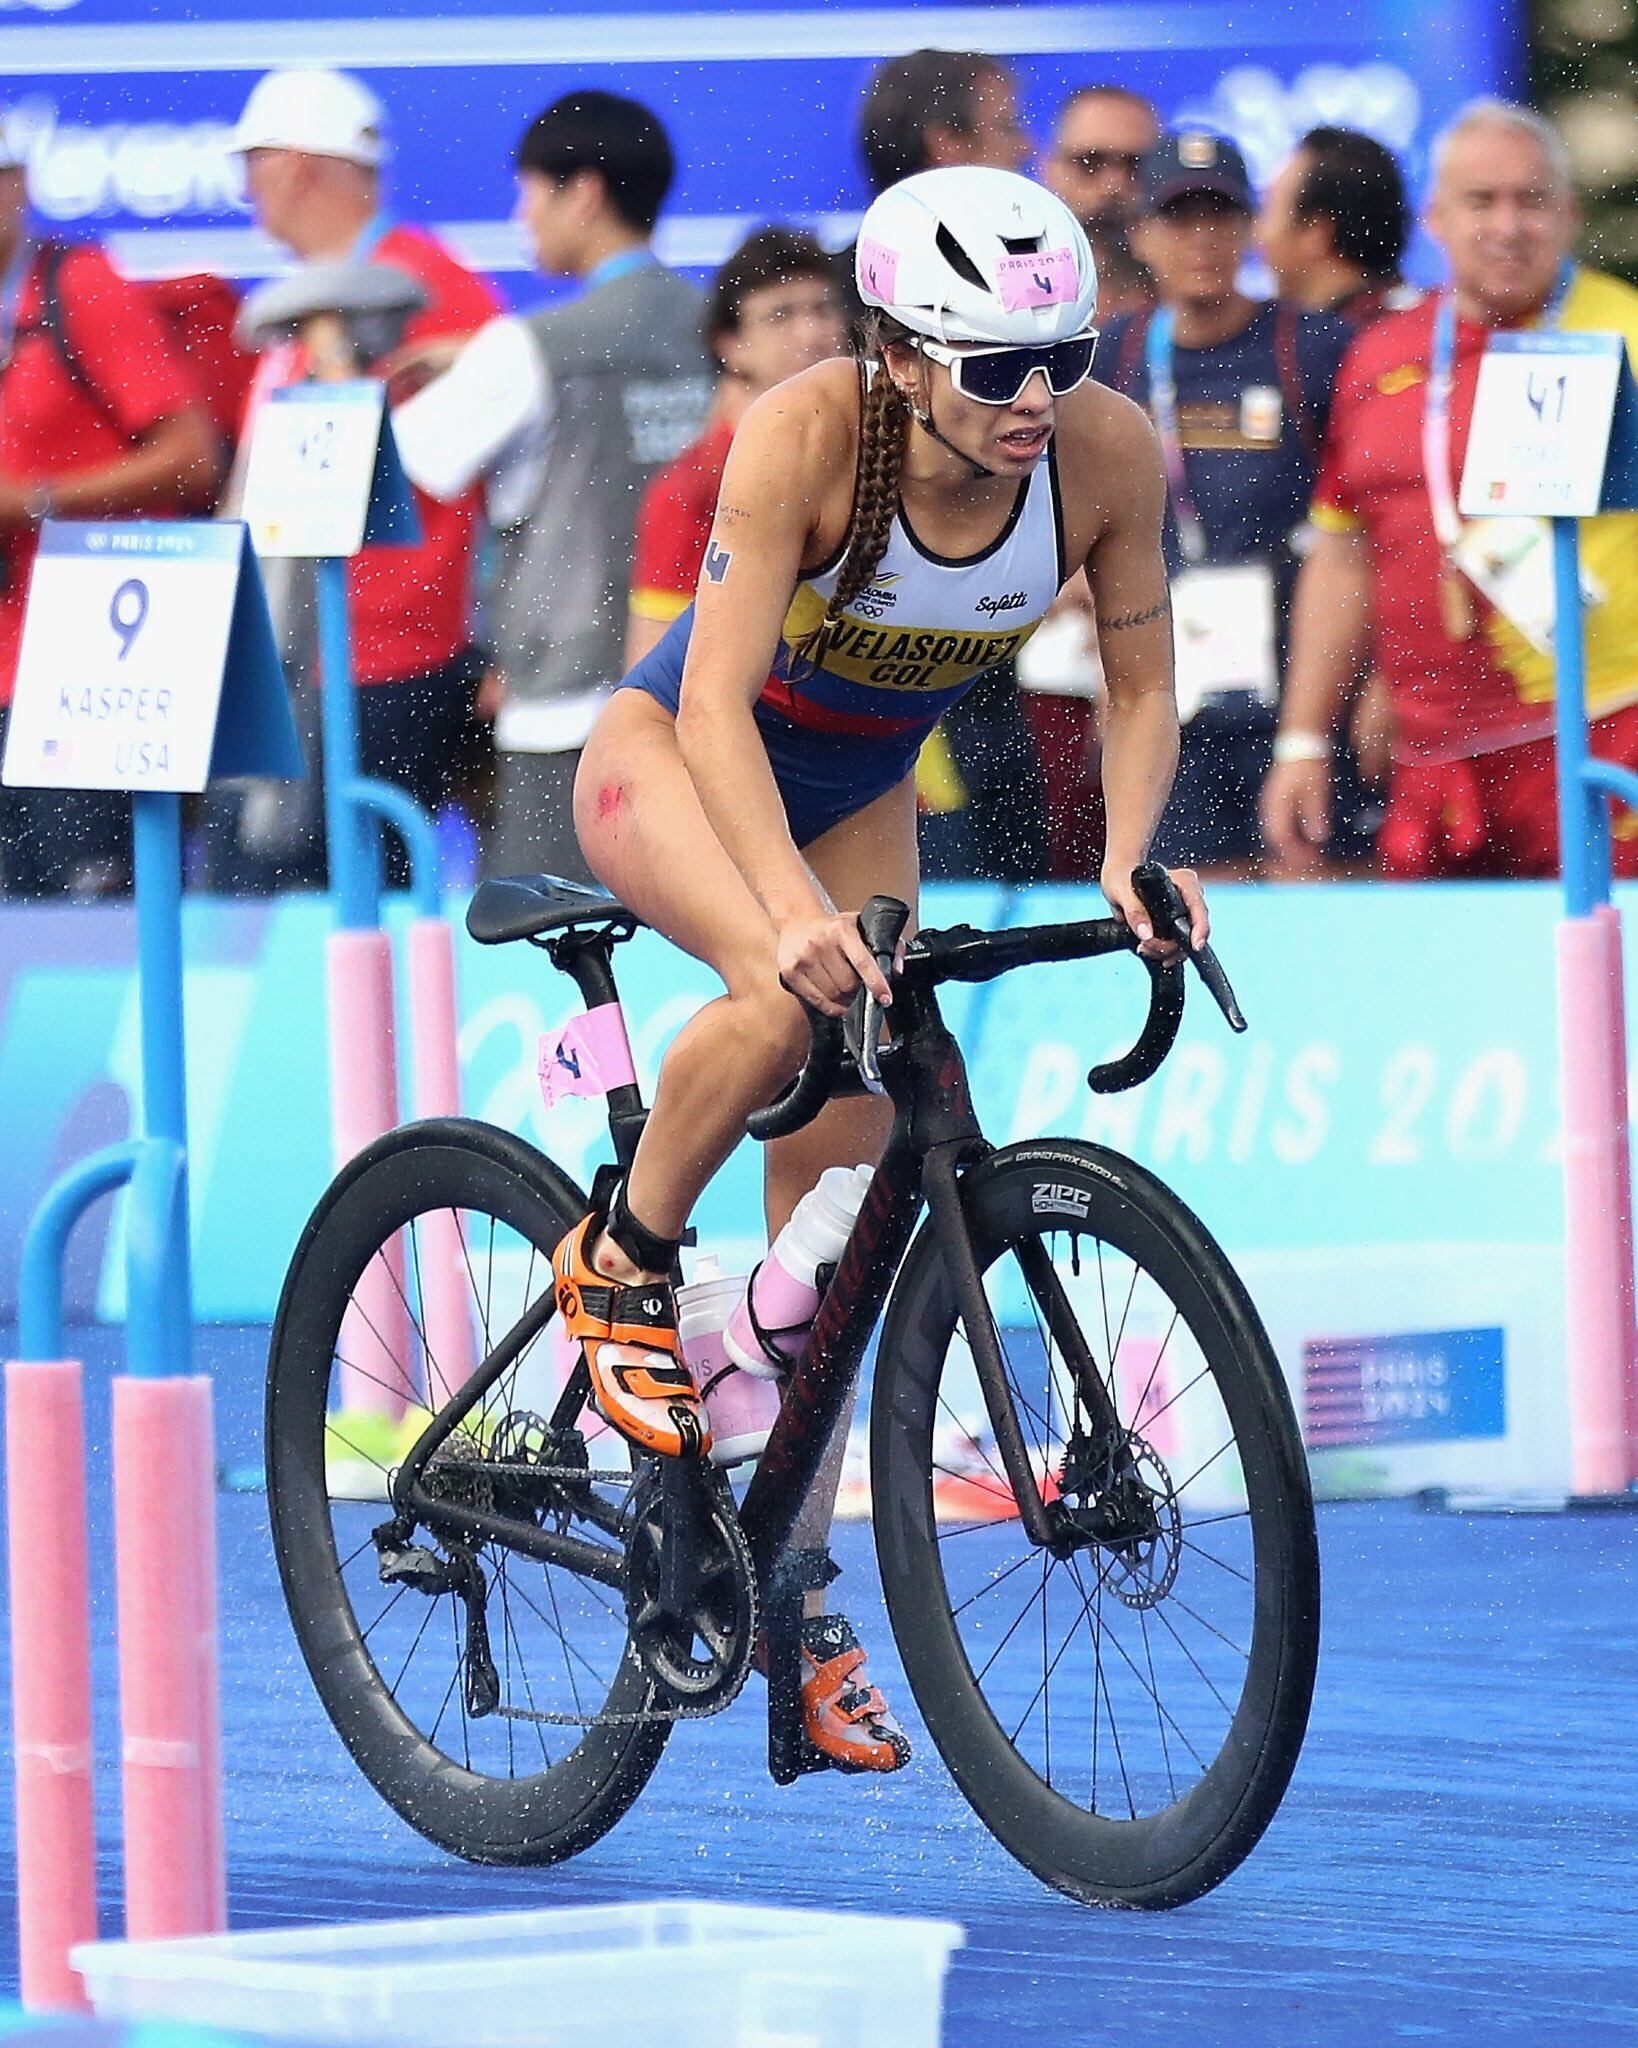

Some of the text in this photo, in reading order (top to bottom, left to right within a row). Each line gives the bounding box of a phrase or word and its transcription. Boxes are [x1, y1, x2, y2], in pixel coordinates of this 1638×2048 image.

[867, 263, 878, 290] 4
[999, 258, 1035, 272] PARIS
[1032, 272, 1053, 295] 4
[1526, 371, 1568, 424] 41
[111, 534, 152, 551] PARIS
[704, 539, 734, 585] 4
[109, 577, 150, 662] 9
[974, 590, 1029, 620] Safetti
[827, 618, 1021, 668] VELASQUEZ
[868, 662, 938, 688] COL
[56, 686, 173, 722] KASPER
[114, 742, 171, 776] USA
[1010, 1040, 1343, 1166] PARIS
[1015, 1150, 1054, 1163] GRAND
[1052, 1152, 1081, 1166] PRIX
[1031, 1182, 1093, 1204] ZIPP
